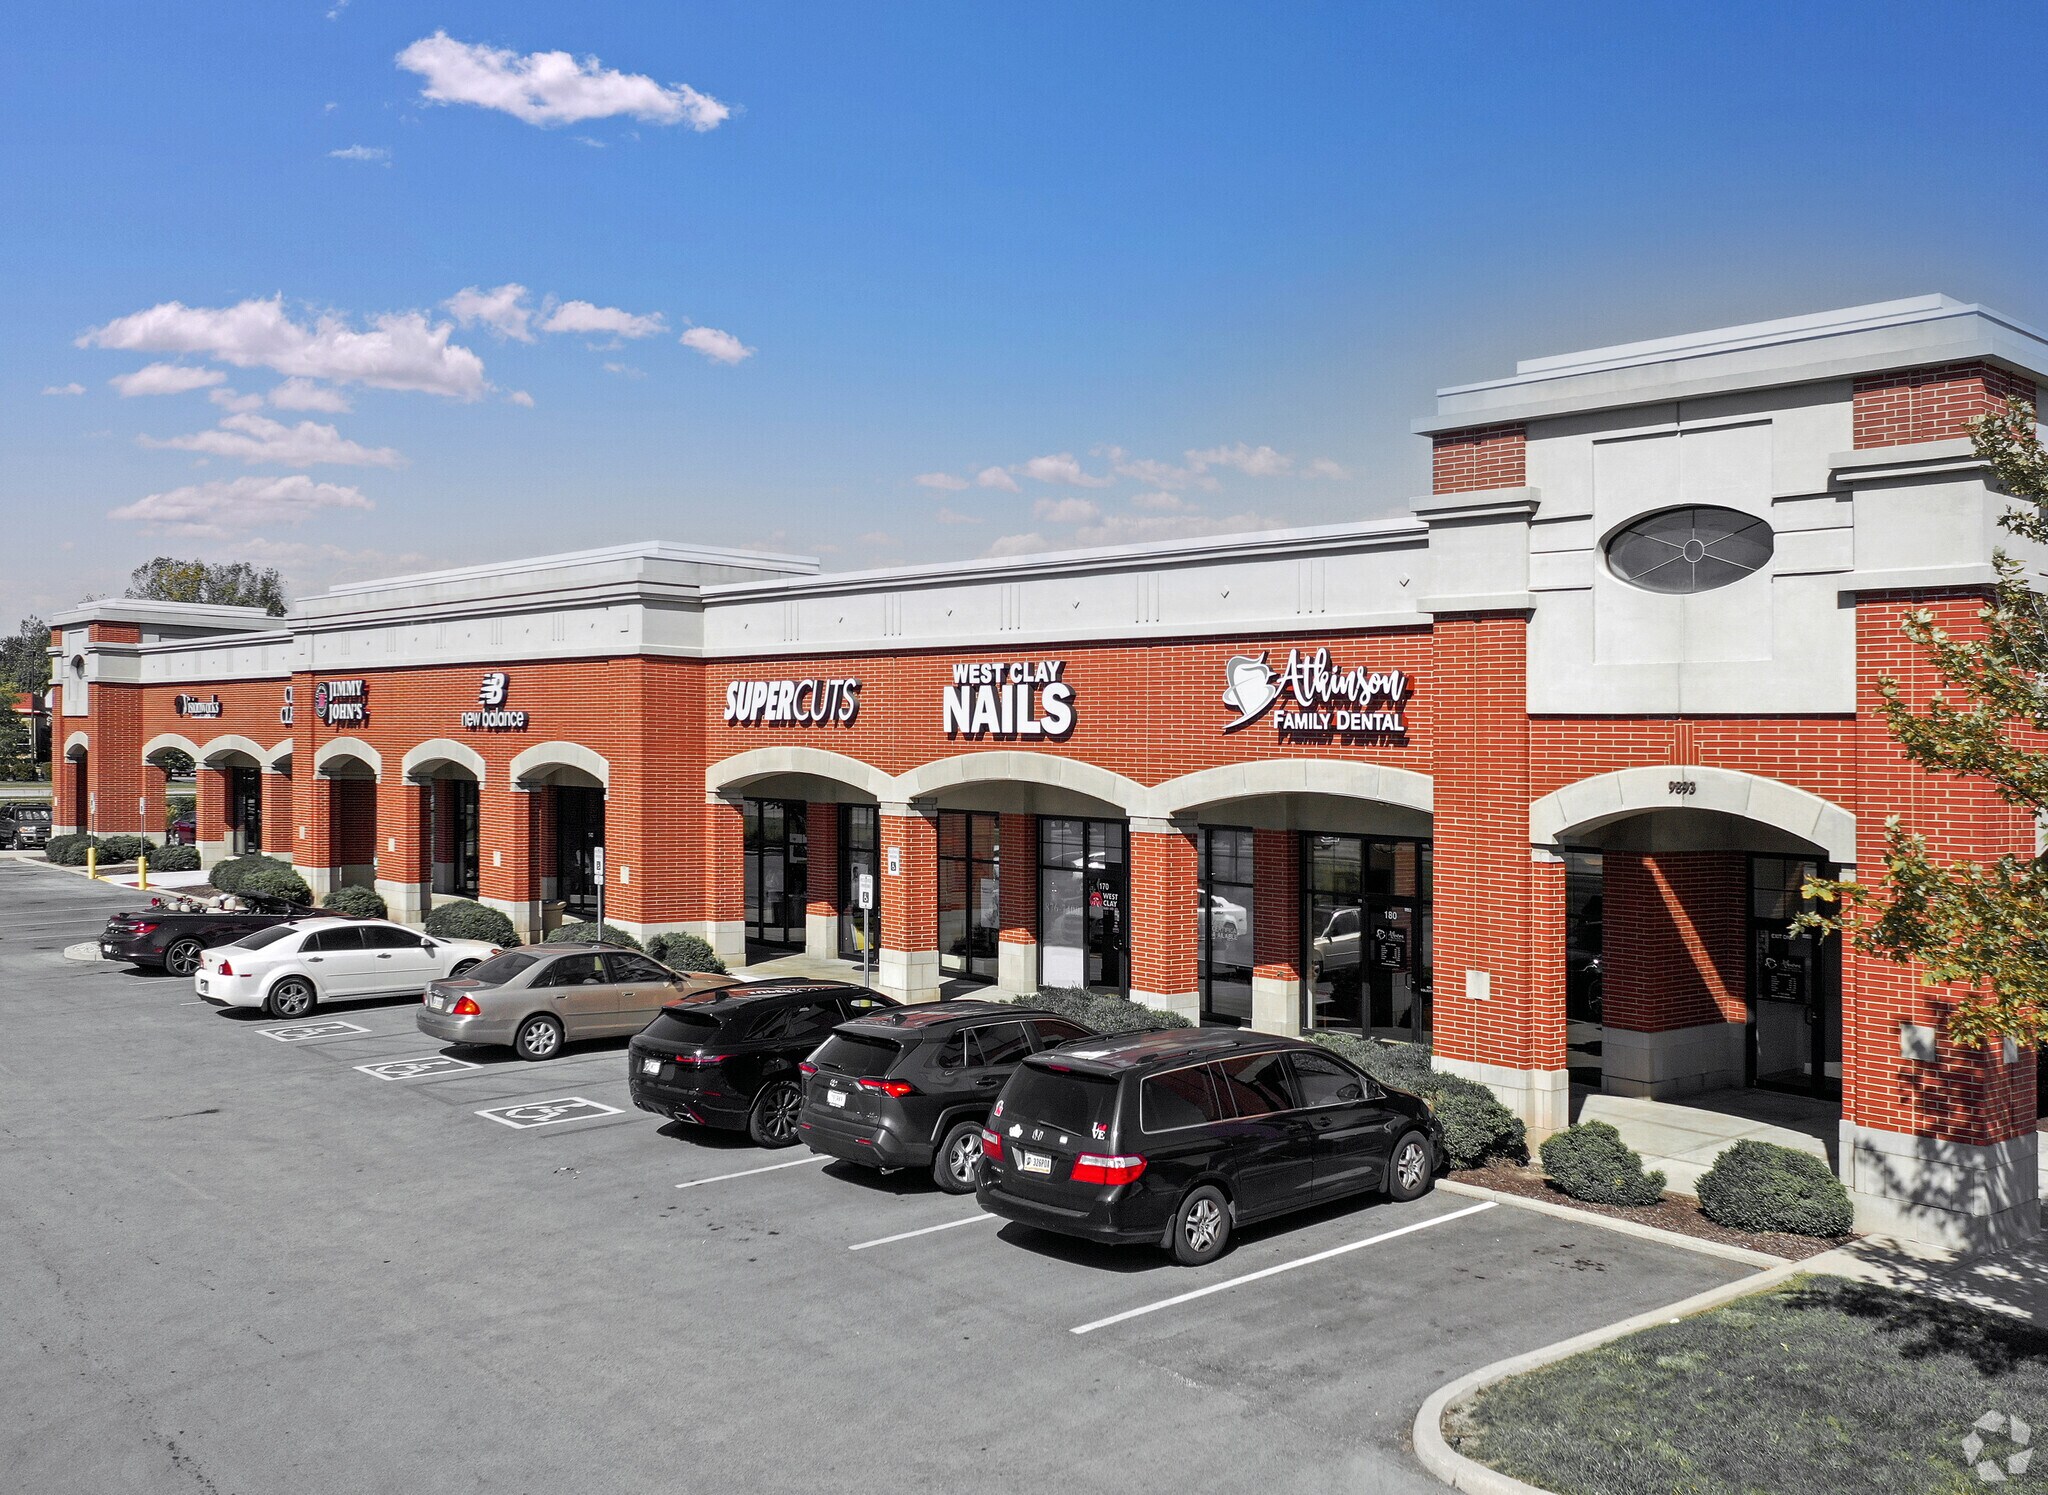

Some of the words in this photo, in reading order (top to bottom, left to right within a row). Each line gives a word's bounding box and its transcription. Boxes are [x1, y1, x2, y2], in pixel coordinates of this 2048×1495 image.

[952, 663, 1005, 684] WEST
[1009, 661, 1061, 684] CLAY
[1273, 647, 1405, 707] Atkinson
[328, 679, 363, 702] JIMMY
[723, 677, 857, 721] SUPERCUTS
[328, 703, 363, 724] JOHN'S
[461, 712, 480, 727] new
[482, 707, 524, 727] balance
[943, 682, 1072, 735] NAILS
[1273, 709, 1331, 730] FAMILY
[1336, 710, 1405, 731] DENTAL
[1668, 780, 1697, 796] 9893
[1102, 892, 1119, 901] WEST
[1102, 900, 1118, 908] CLAY
[1384, 910, 1398, 920] 180
